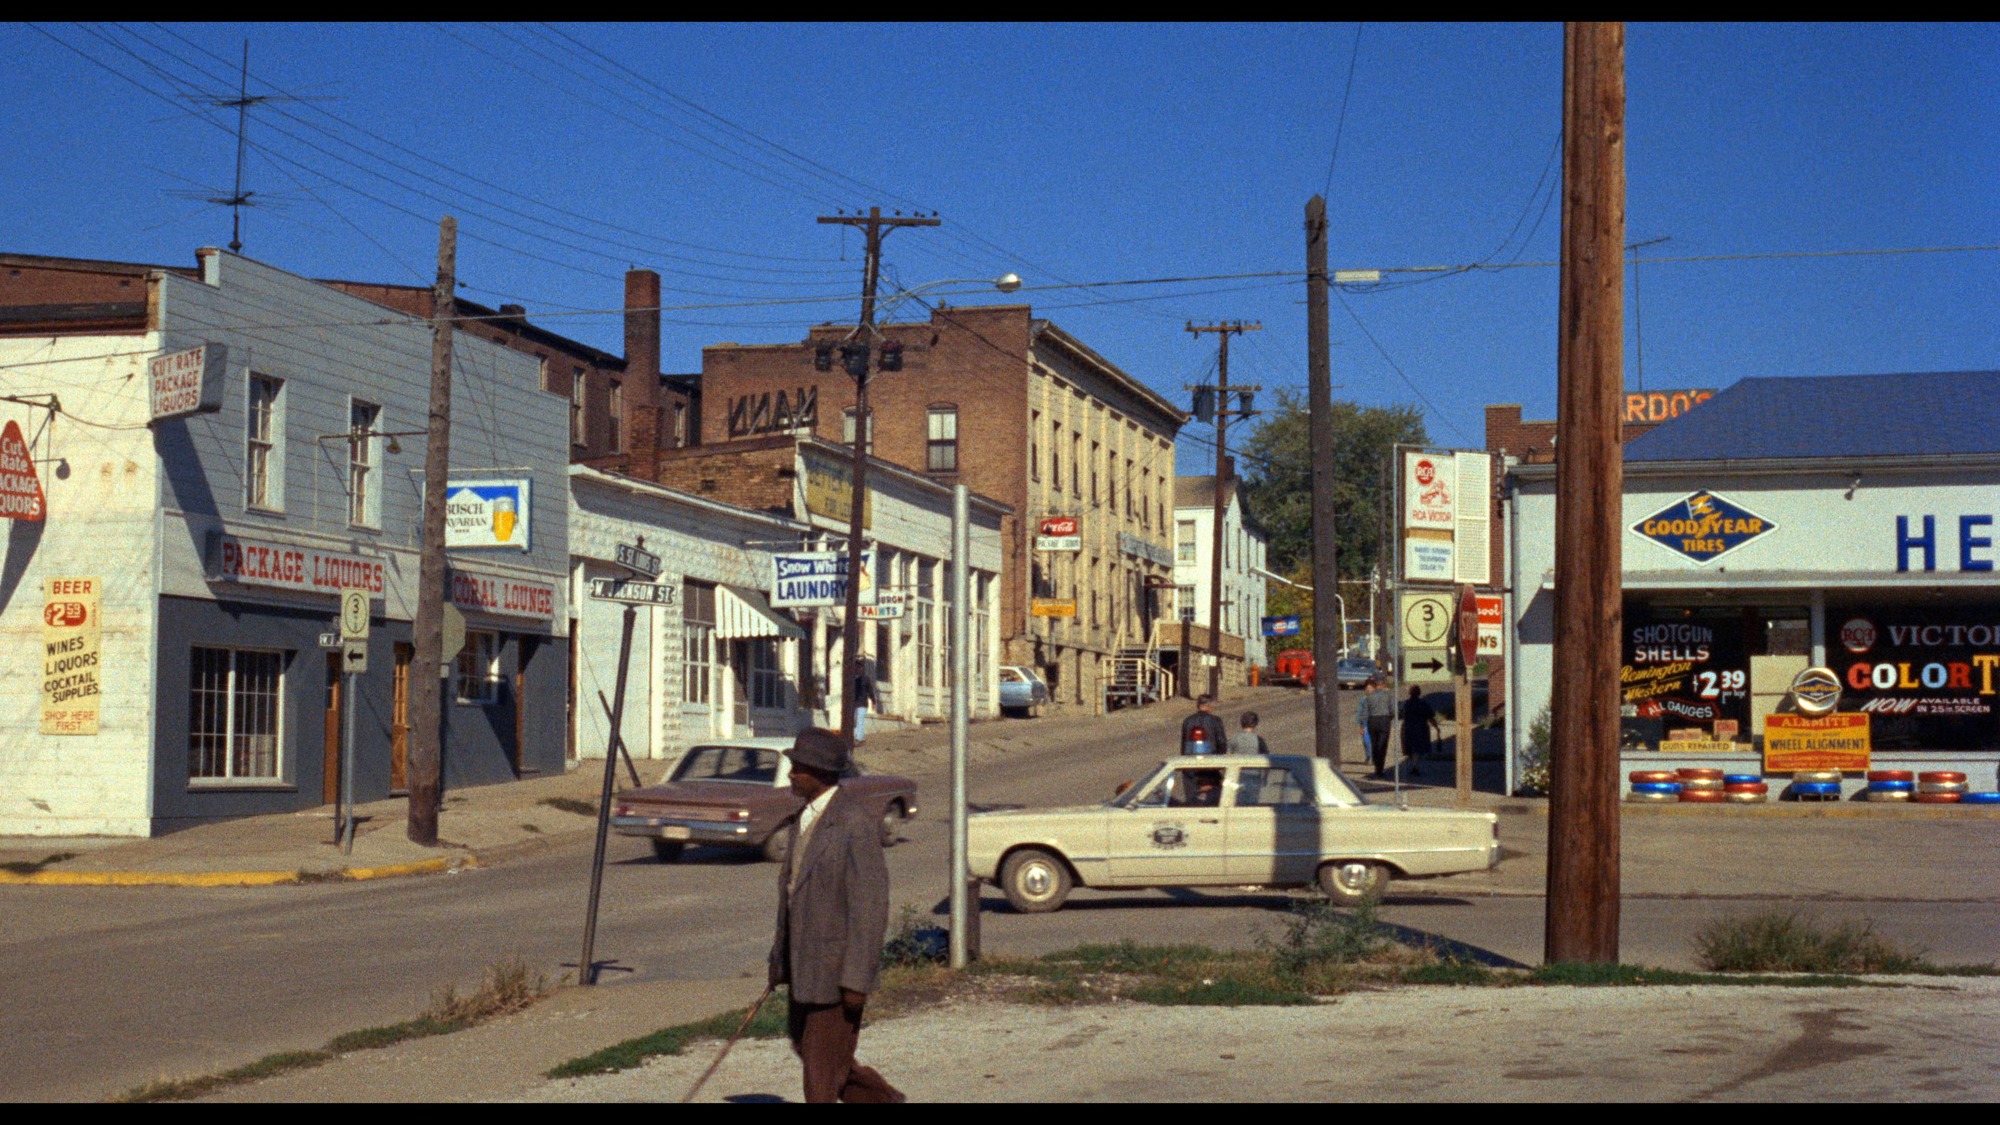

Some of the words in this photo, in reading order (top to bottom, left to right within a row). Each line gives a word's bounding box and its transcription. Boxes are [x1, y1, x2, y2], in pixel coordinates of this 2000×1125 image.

[152, 358, 172, 378] CUT
[177, 349, 202, 370] RATE
[155, 370, 198, 394] PACKAGE
[153, 390, 198, 414] LIQUORS
[2, 438, 24, 456] Cut
[1, 454, 29, 473] Rate
[1413, 510, 1427, 520] RCA
[1429, 510, 1452, 522] VICTOR
[1643, 518, 1763, 536] GOODYEAR
[1681, 539, 1725, 552] TIRES
[1896, 514, 1994, 573] HE
[222, 542, 304, 584] PACKAGE
[312, 555, 384, 593] LIQUORS
[778, 560, 811, 577] Snow
[814, 557, 850, 574] White
[52, 580, 92, 595] BEER
[454, 575, 498, 607] CORAL
[504, 583, 553, 615] LOUNGE
[777, 580, 849, 600] LAUNDRY
[353, 598, 360, 614] 3
[860, 607, 898, 617] PAINTS
[1421, 604, 1435, 622] 3
[1632, 624, 1713, 644] SHOTGUN
[46, 636, 84, 656] WINES
[1634, 645, 1710, 662] SHELLS
[45, 651, 98, 676] LIQUORS
[1621, 662, 1692, 683] Remington
[44, 671, 96, 693] COCKTAIL
[1624, 680, 1682, 700] Western
[1648, 702, 1666, 715] ALL
[1667, 701, 1714, 718] GAUGES
[1859, 697, 1919, 713] NOW
[1920, 697, 1981, 705] AVAILABLE
[1917, 705, 1927, 713] IN
[1955, 705, 1991, 713] SCREEN
[44, 710, 67, 721] SHOP
[71, 710, 95, 721] HERE
[55, 721, 82, 731] FIRST
[1687, 742, 1730, 751] REPAIRED
[1769, 739, 1803, 750] WHEEL
[1805, 738, 1865, 750] ALIGNMENT
